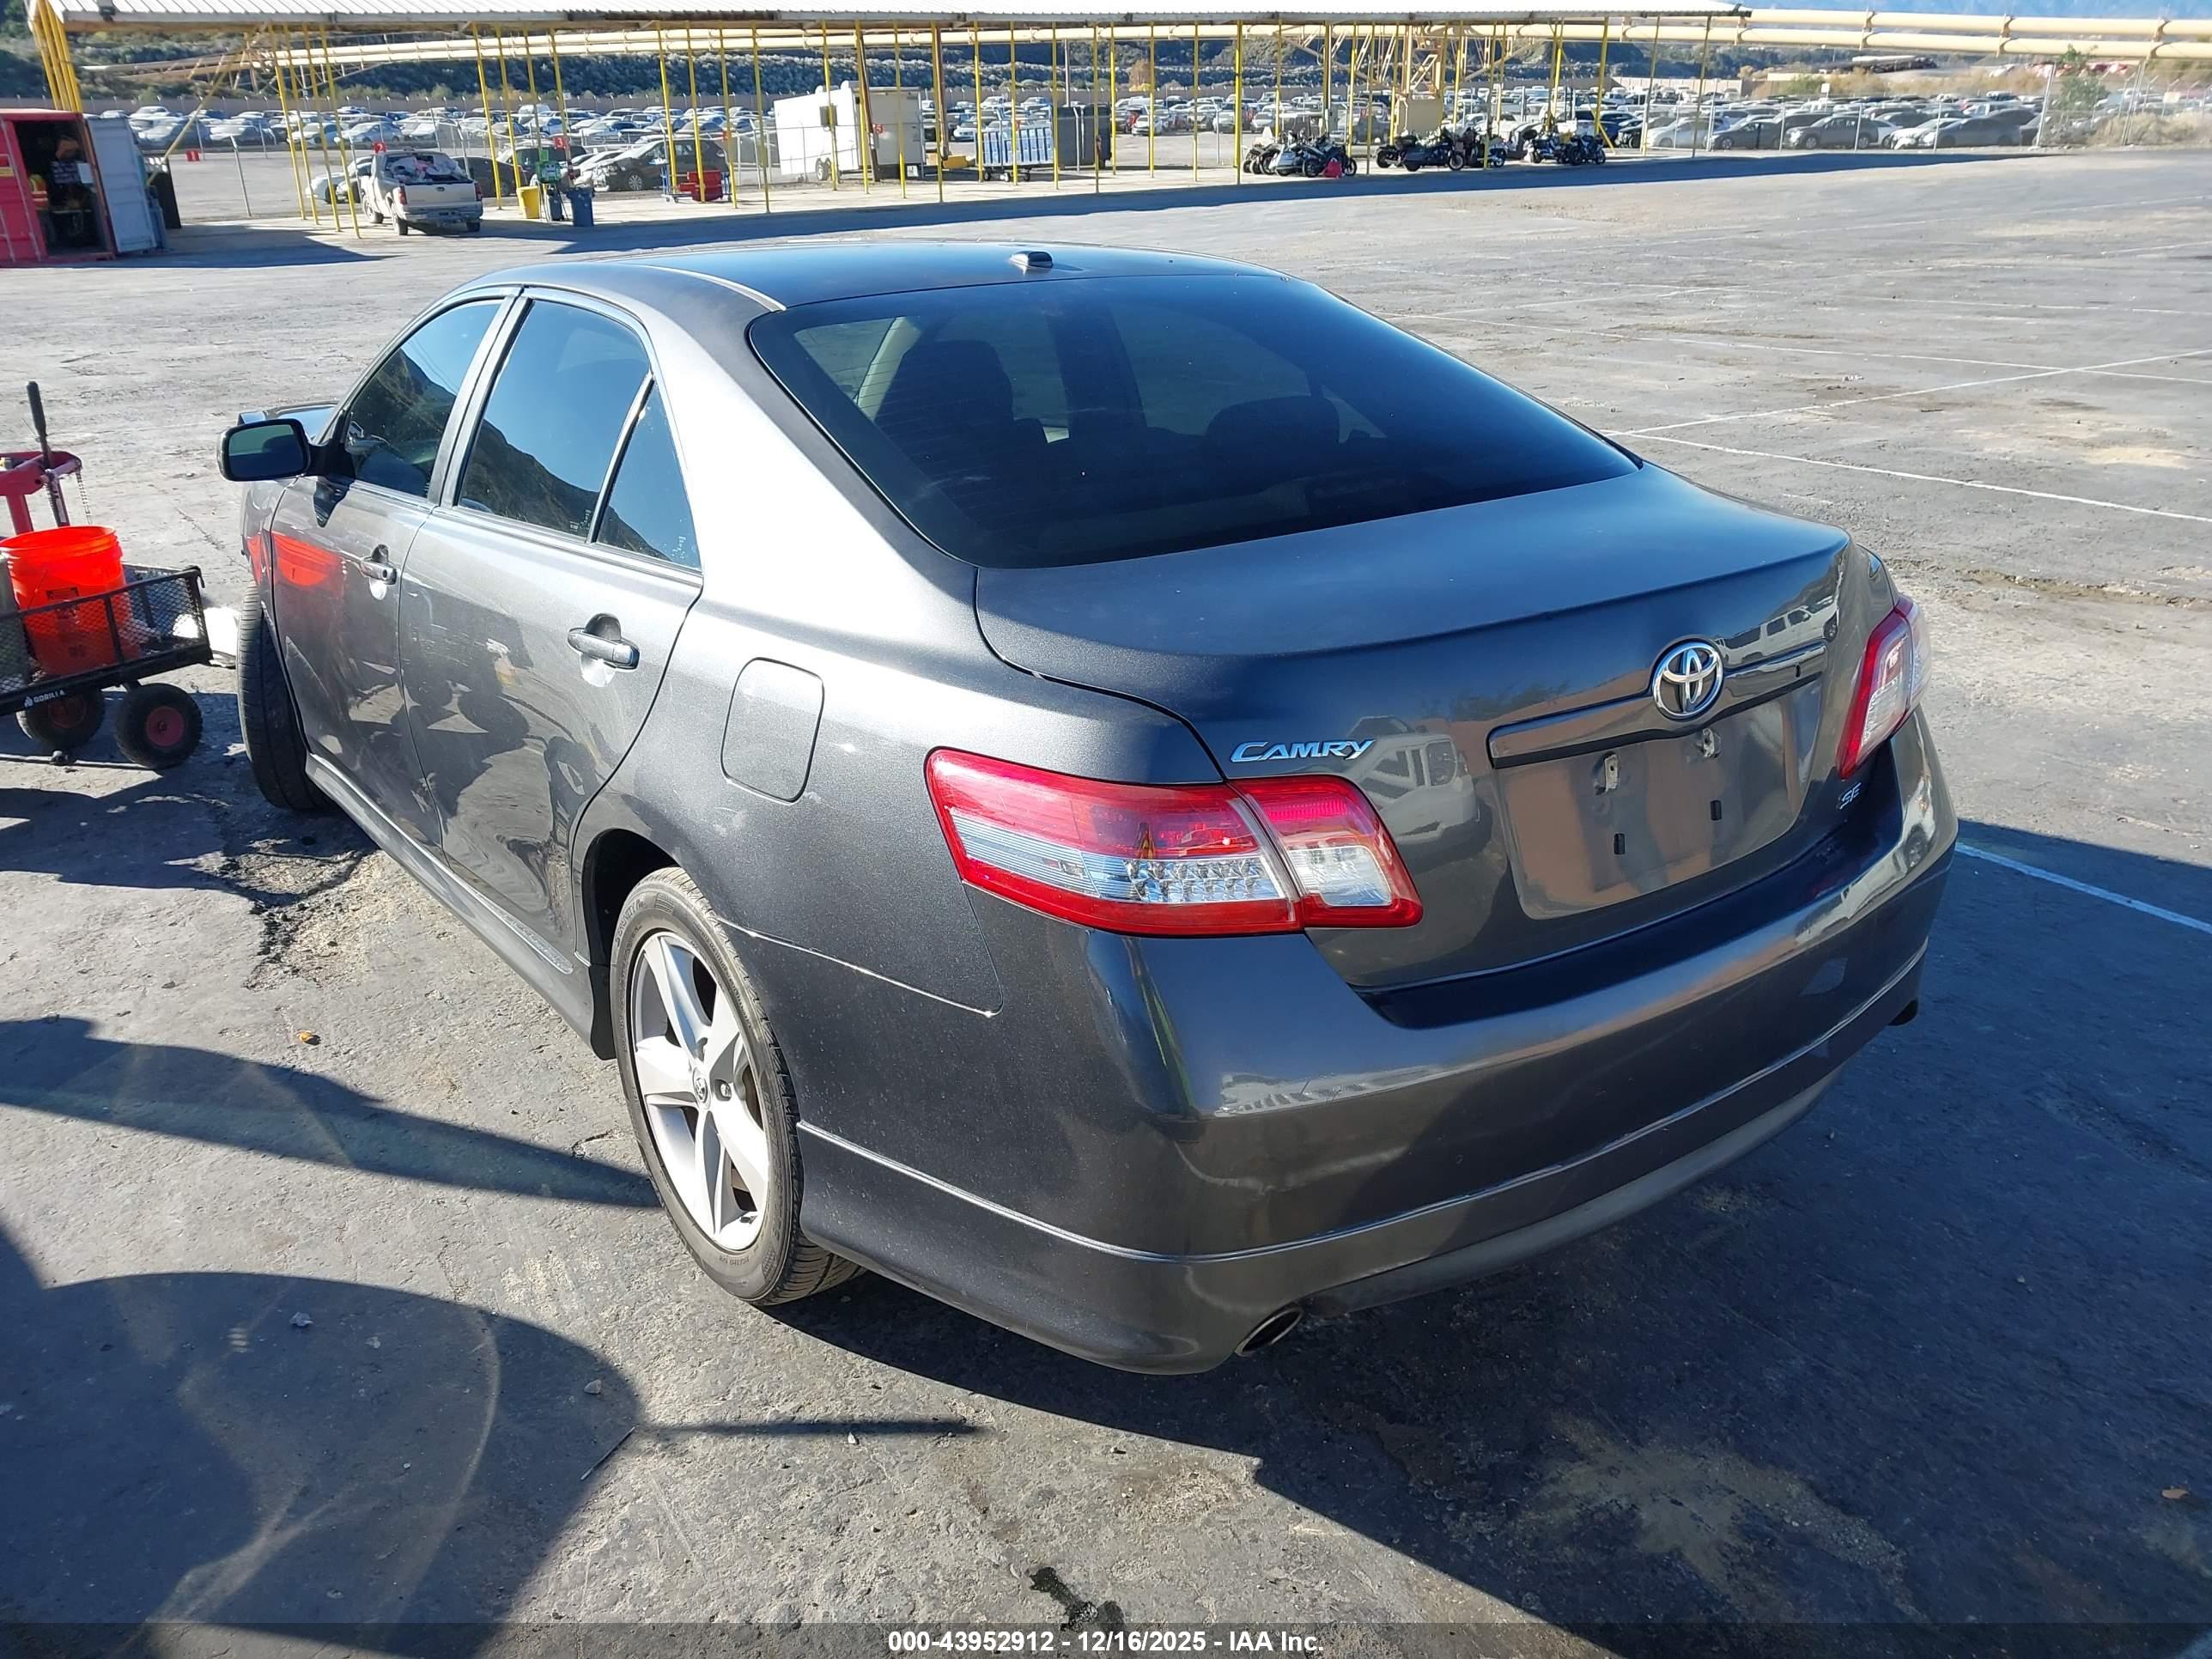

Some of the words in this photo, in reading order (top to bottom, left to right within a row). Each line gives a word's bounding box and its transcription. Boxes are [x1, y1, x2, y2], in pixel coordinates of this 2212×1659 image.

[33, 690, 65, 703] GORILLA
[1231, 739, 1376, 763] CAMRY
[1839, 782, 1862, 810] SE
